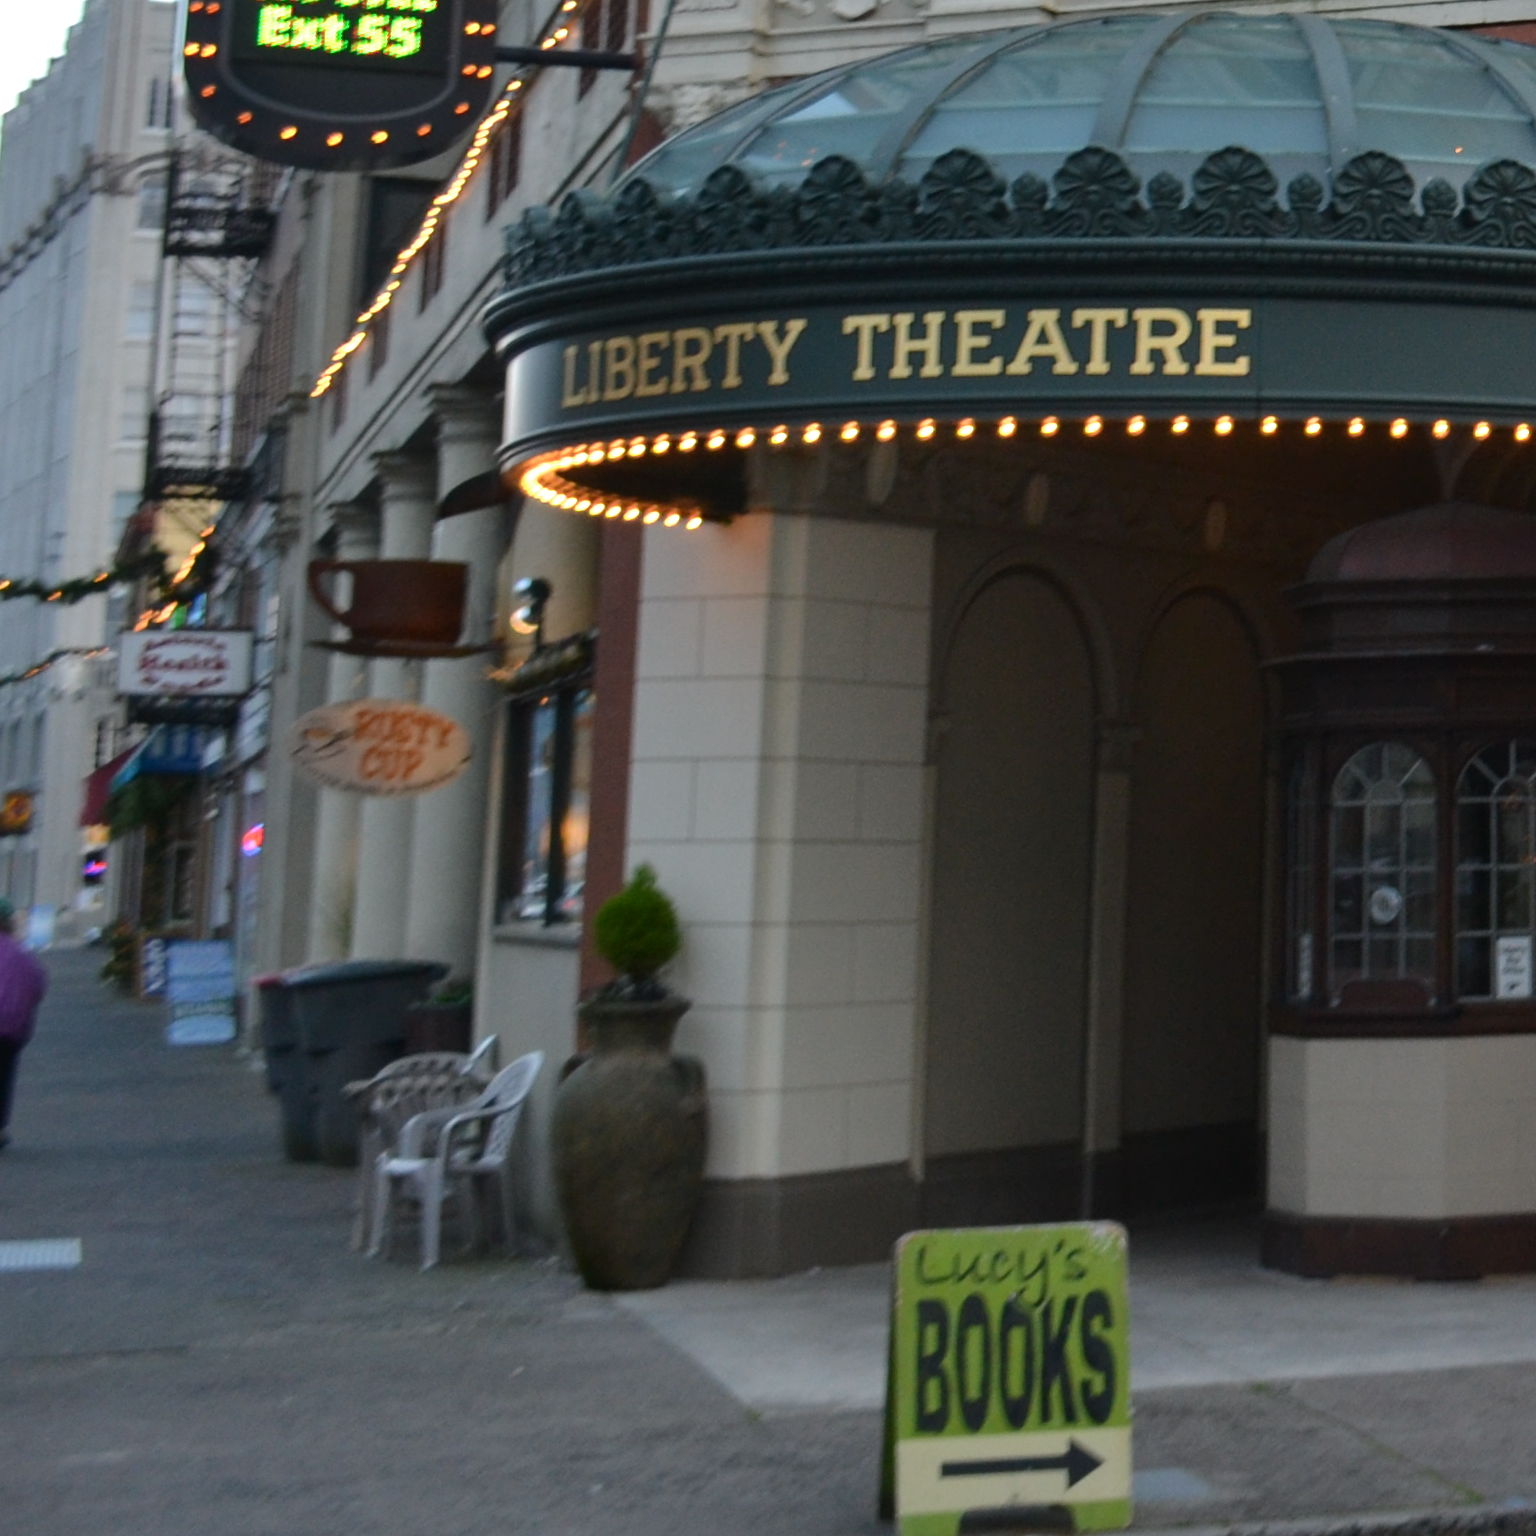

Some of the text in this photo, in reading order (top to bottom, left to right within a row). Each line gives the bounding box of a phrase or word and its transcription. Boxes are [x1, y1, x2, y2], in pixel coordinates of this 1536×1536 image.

[257, 3, 423, 58] Ext 55
[562, 307, 1252, 409] LIBERTY THEATRE
[914, 1238, 1089, 1308] Lucy's
[914, 1289, 1117, 1434] BOOKS
